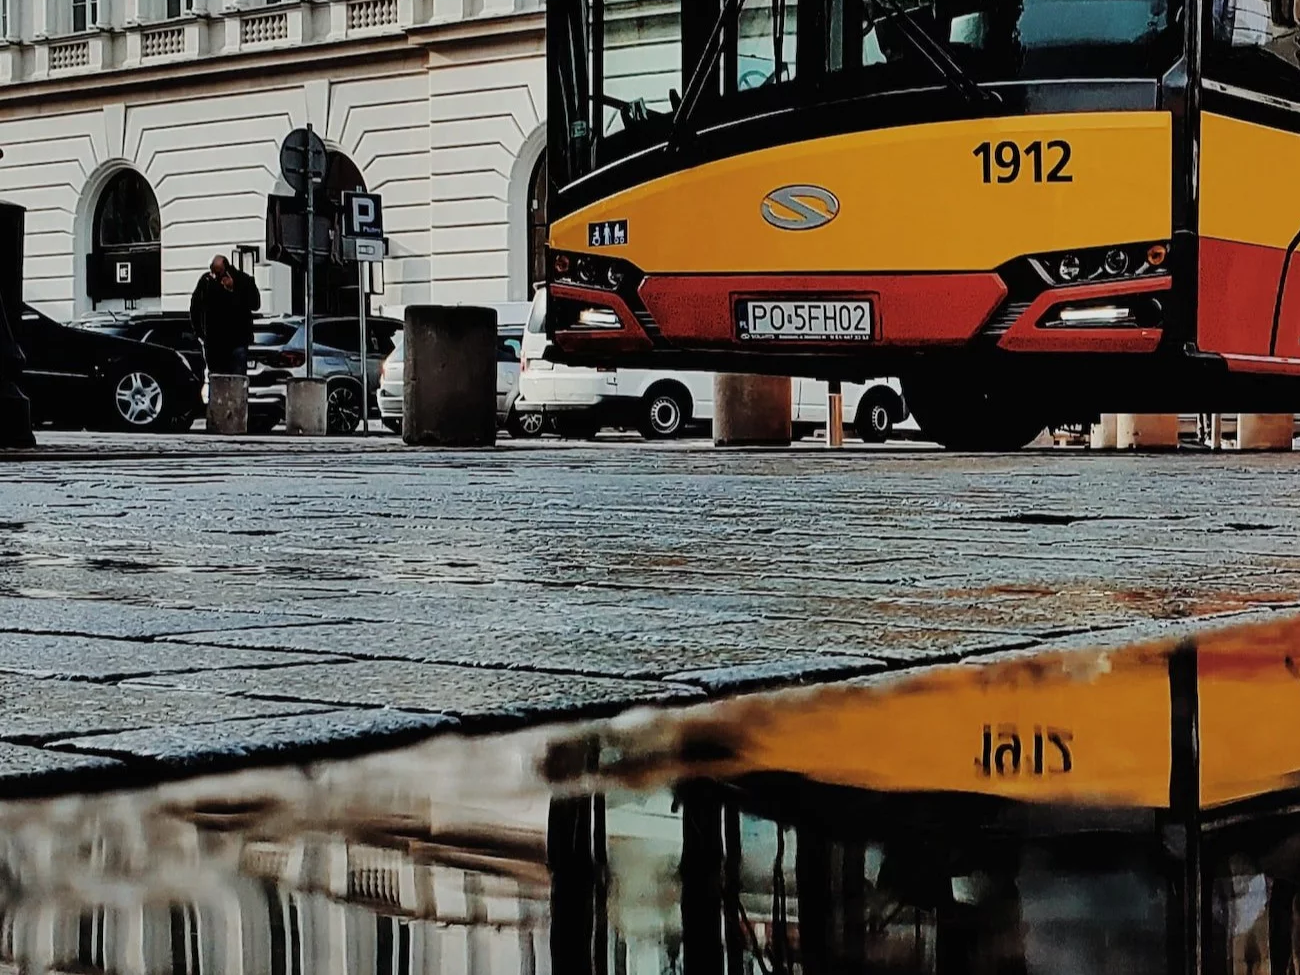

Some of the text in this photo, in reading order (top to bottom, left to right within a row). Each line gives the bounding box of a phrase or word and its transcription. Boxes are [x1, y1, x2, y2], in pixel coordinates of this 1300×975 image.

[972, 140, 1073, 184] 1912
[352, 197, 375, 232] P
[752, 304, 867, 331] PO 5FH02
